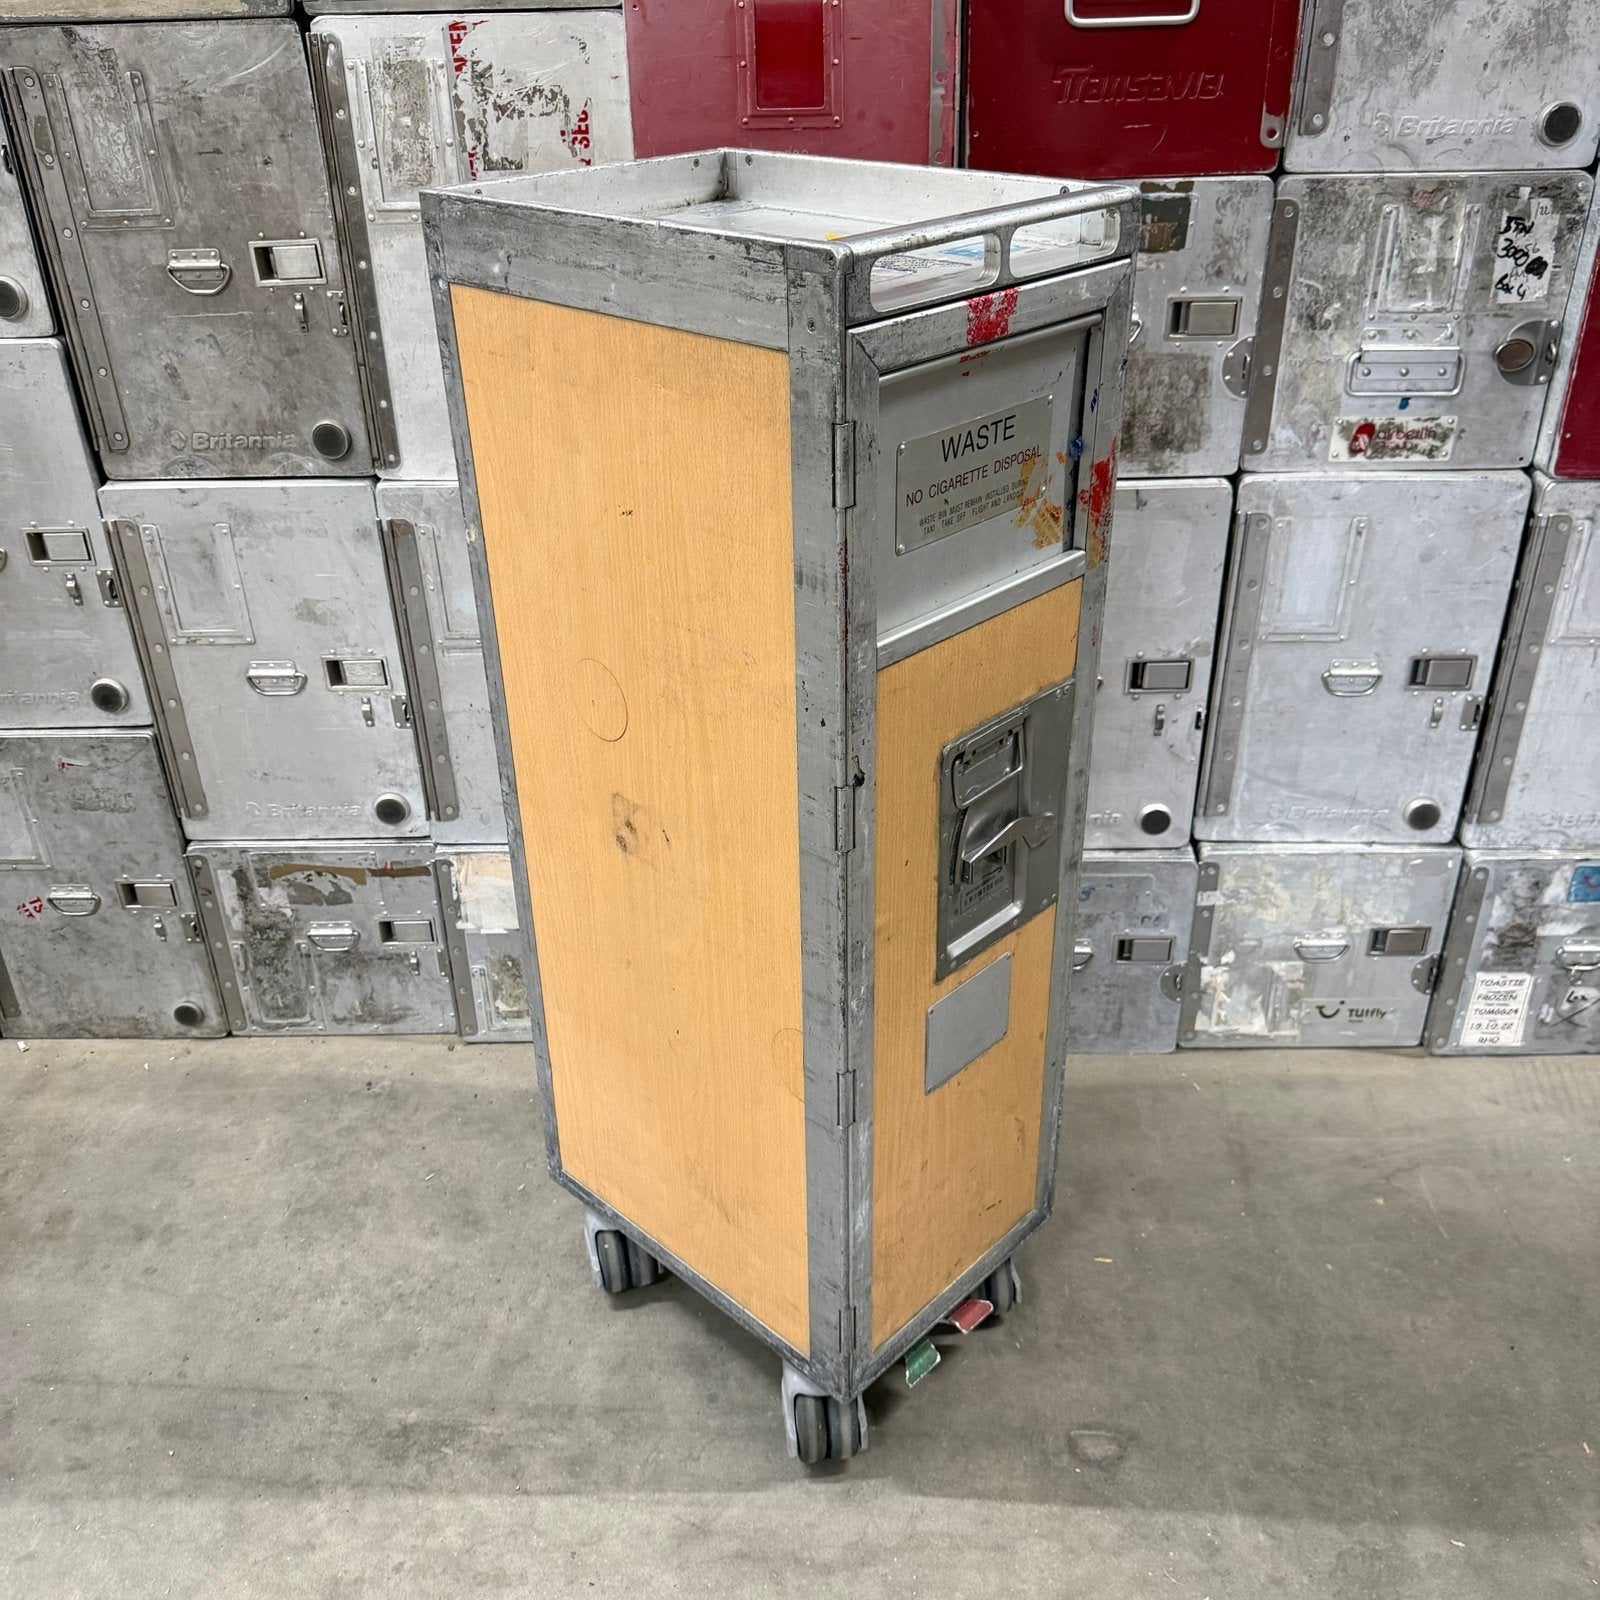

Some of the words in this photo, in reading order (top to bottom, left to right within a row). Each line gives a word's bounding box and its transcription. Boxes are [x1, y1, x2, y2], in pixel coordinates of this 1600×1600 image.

[191, 430, 297, 451] Britannia
[942, 414, 1017, 463] WASTE
[906, 489, 924, 508] NO
[928, 465, 989, 498] CIGARETTE
[993, 445, 1042, 474] DISPOSAL
[919, 513, 936, 527] WASTE
[949, 502, 964, 515] MUST
[965, 496, 983, 509] REMAIN
[985, 484, 1010, 501] INSTALLED
[972, 501, 990, 516] FLIGHT
[990, 497, 1002, 508] AND
[1479, 979, 1527, 987] TOASTIE
[1347, 1007, 1388, 1019] TUIfly
